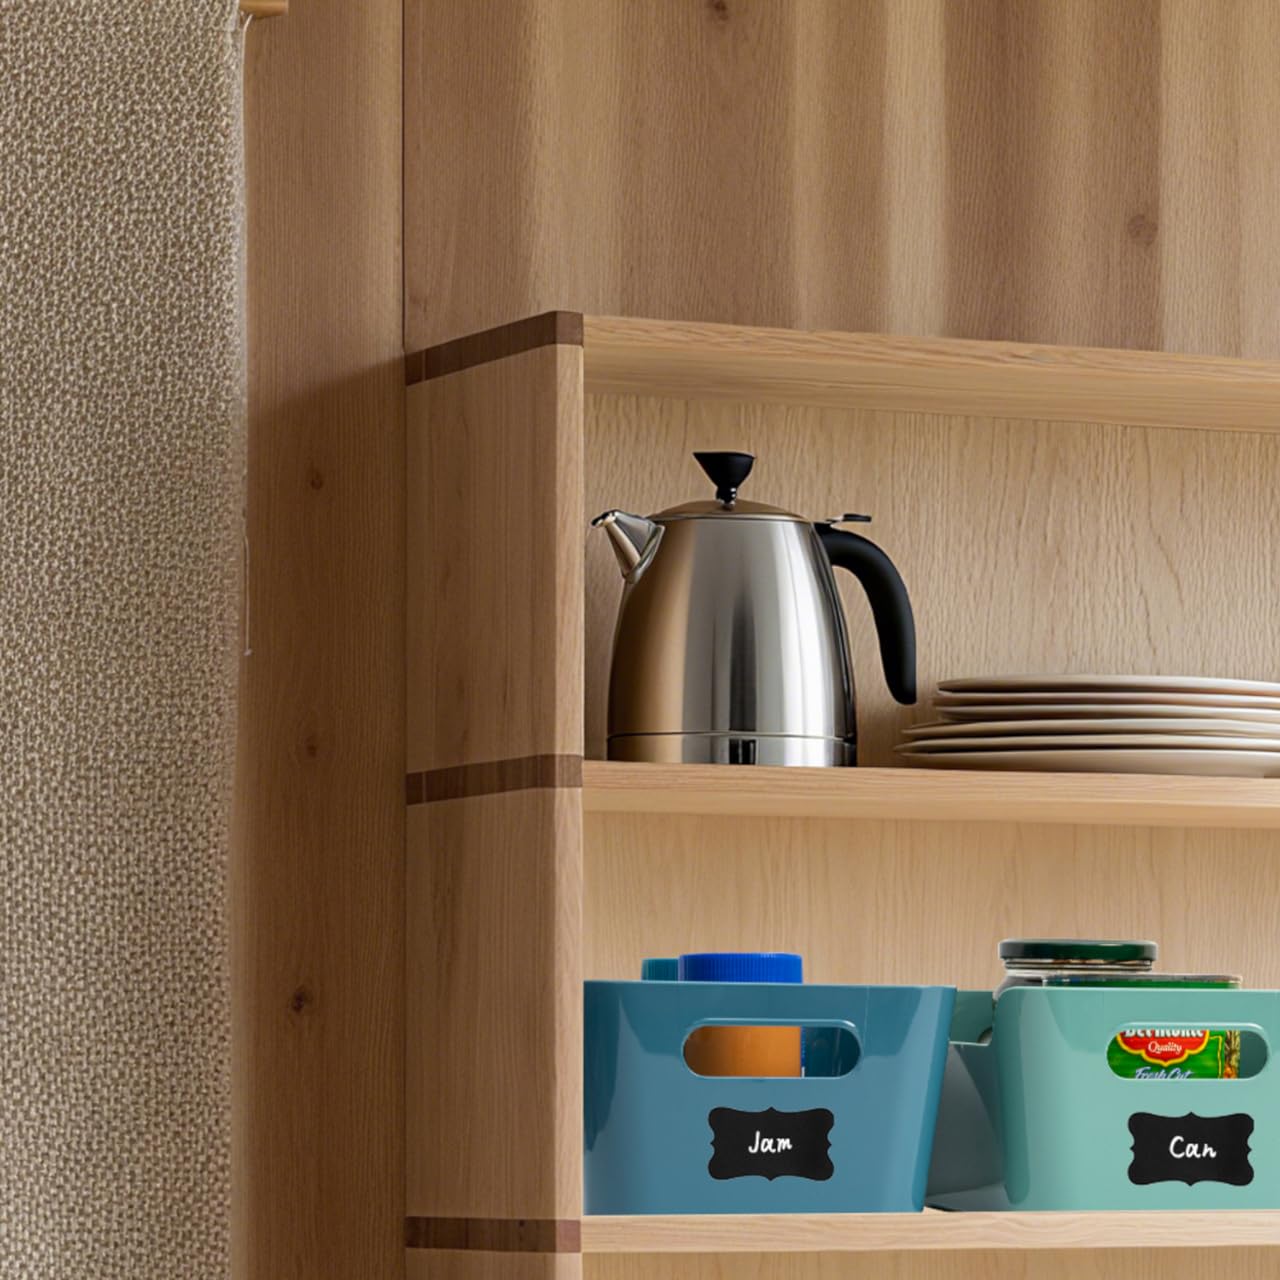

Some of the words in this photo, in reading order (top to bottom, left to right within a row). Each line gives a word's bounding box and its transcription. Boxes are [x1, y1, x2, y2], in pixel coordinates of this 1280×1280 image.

[1148, 1040, 1182, 1055] Quality
[748, 1130, 793, 1154] Jam
[1169, 1135, 1217, 1159] Can
